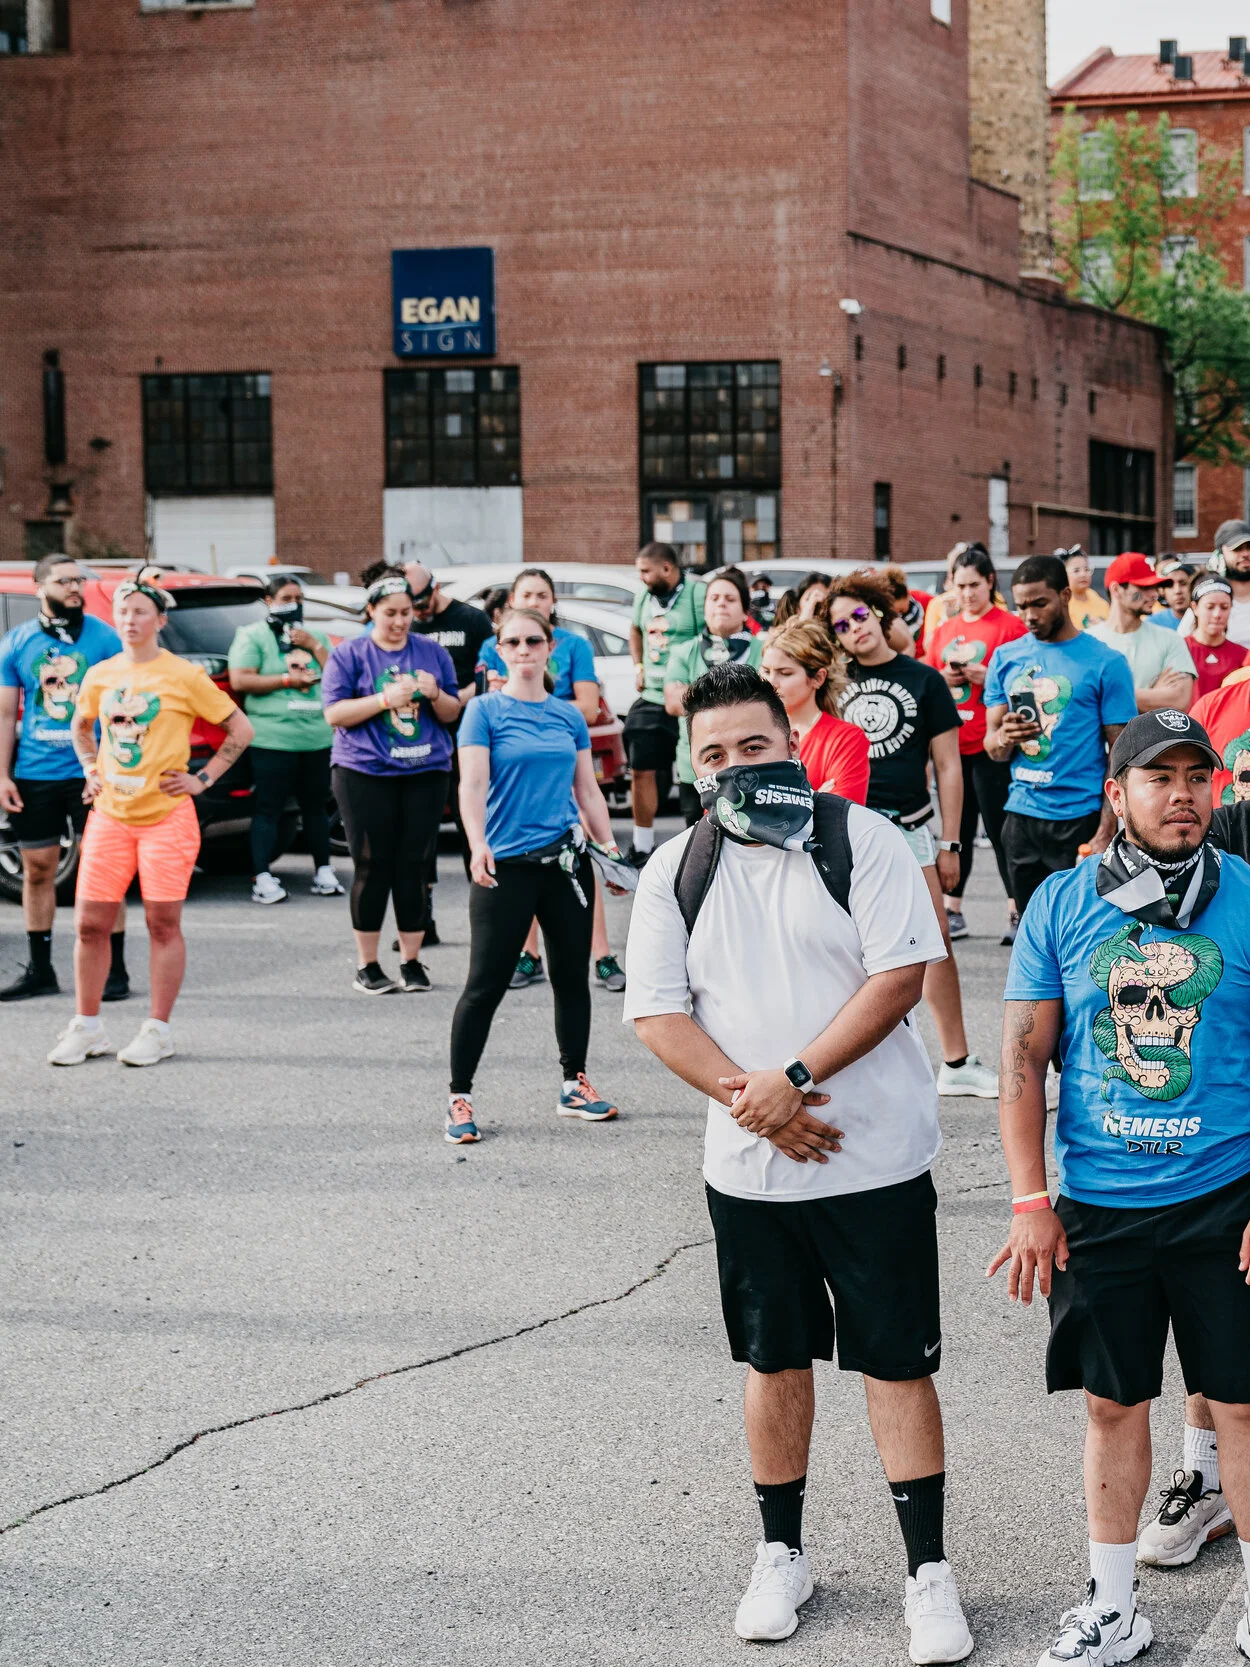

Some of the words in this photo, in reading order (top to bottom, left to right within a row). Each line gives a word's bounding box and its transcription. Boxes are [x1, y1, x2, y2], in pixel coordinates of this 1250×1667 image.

[401, 296, 480, 323] EGAN
[401, 329, 481, 352] SIGN
[1103, 1111, 1201, 1138] NEMESIS
[1125, 1139, 1184, 1156] DTLR
